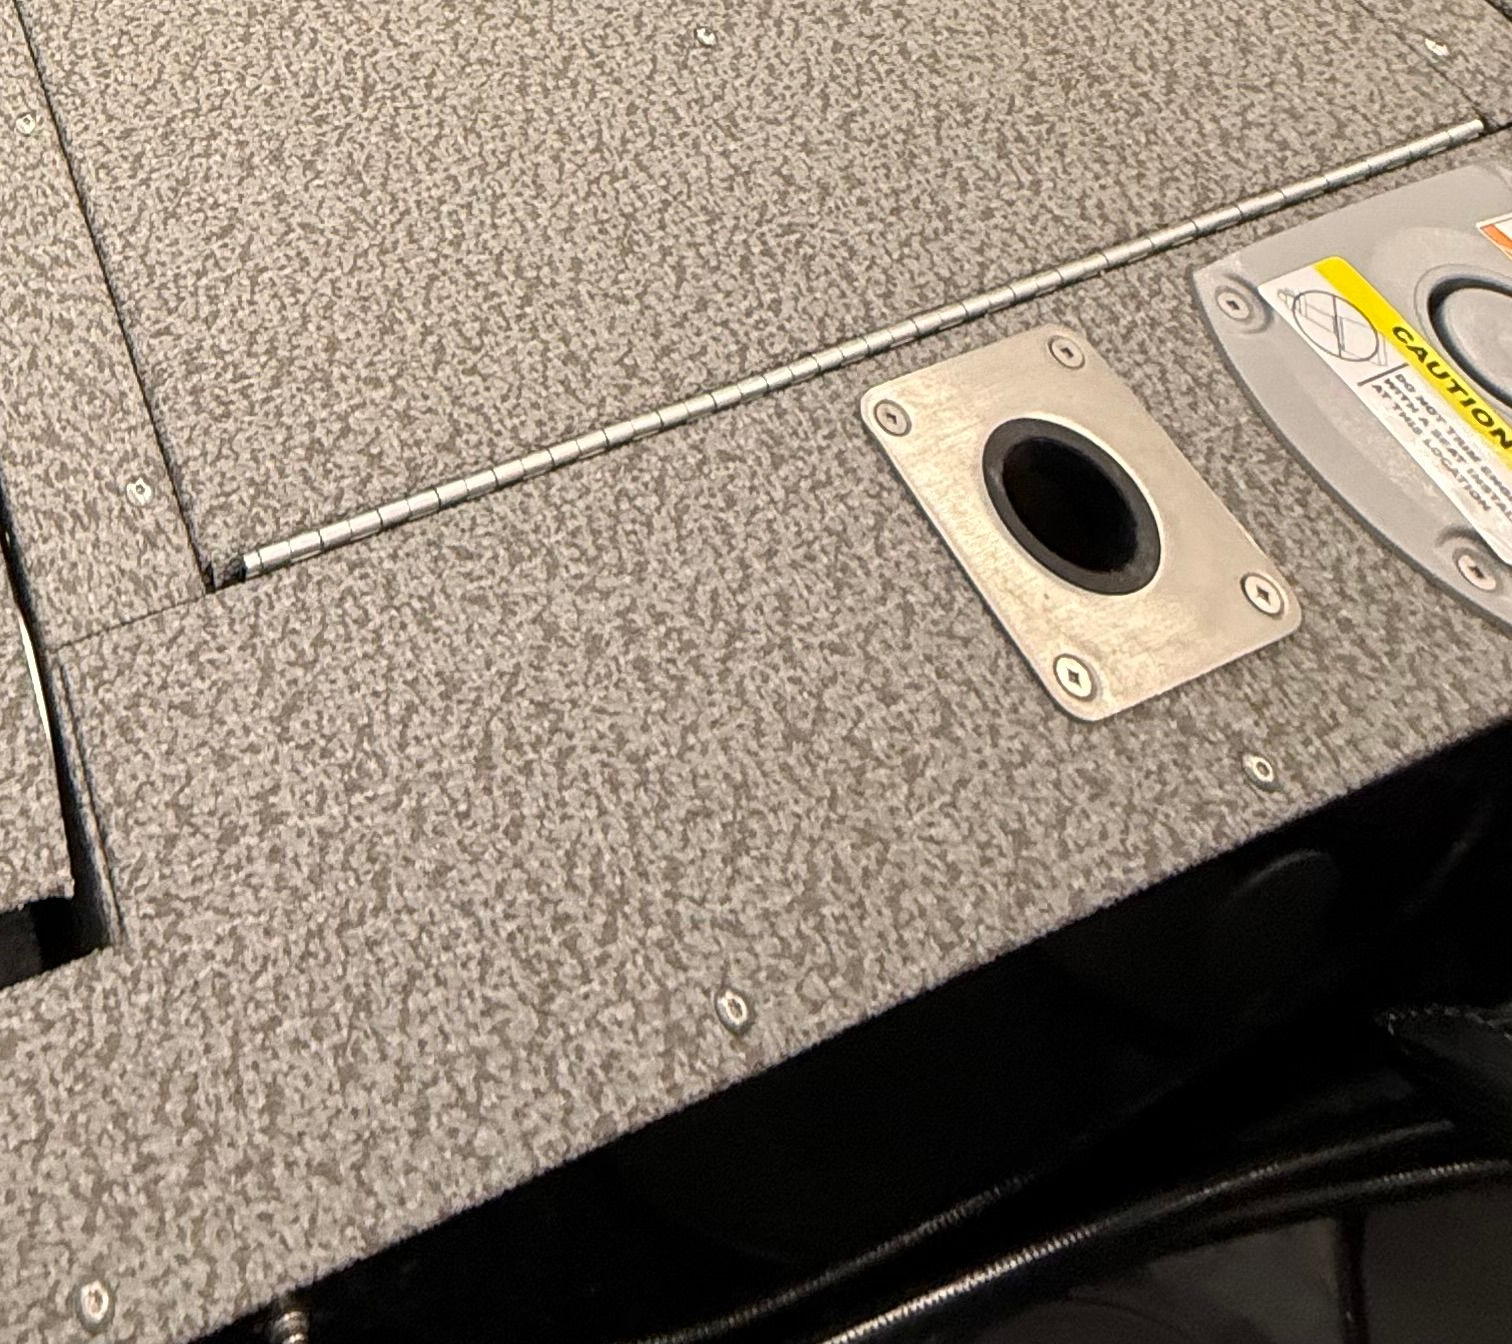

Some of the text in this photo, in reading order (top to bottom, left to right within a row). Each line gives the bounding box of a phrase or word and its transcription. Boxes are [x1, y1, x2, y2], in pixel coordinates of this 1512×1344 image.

[1371, 384, 1491, 511] AT THIS LOCATION
[1384, 378, 1512, 522] WITH A SEAT INSTAL
[1392, 326, 1512, 449] CAUTION
[1395, 374, 1512, 502] DO NOT TRIM ENG
